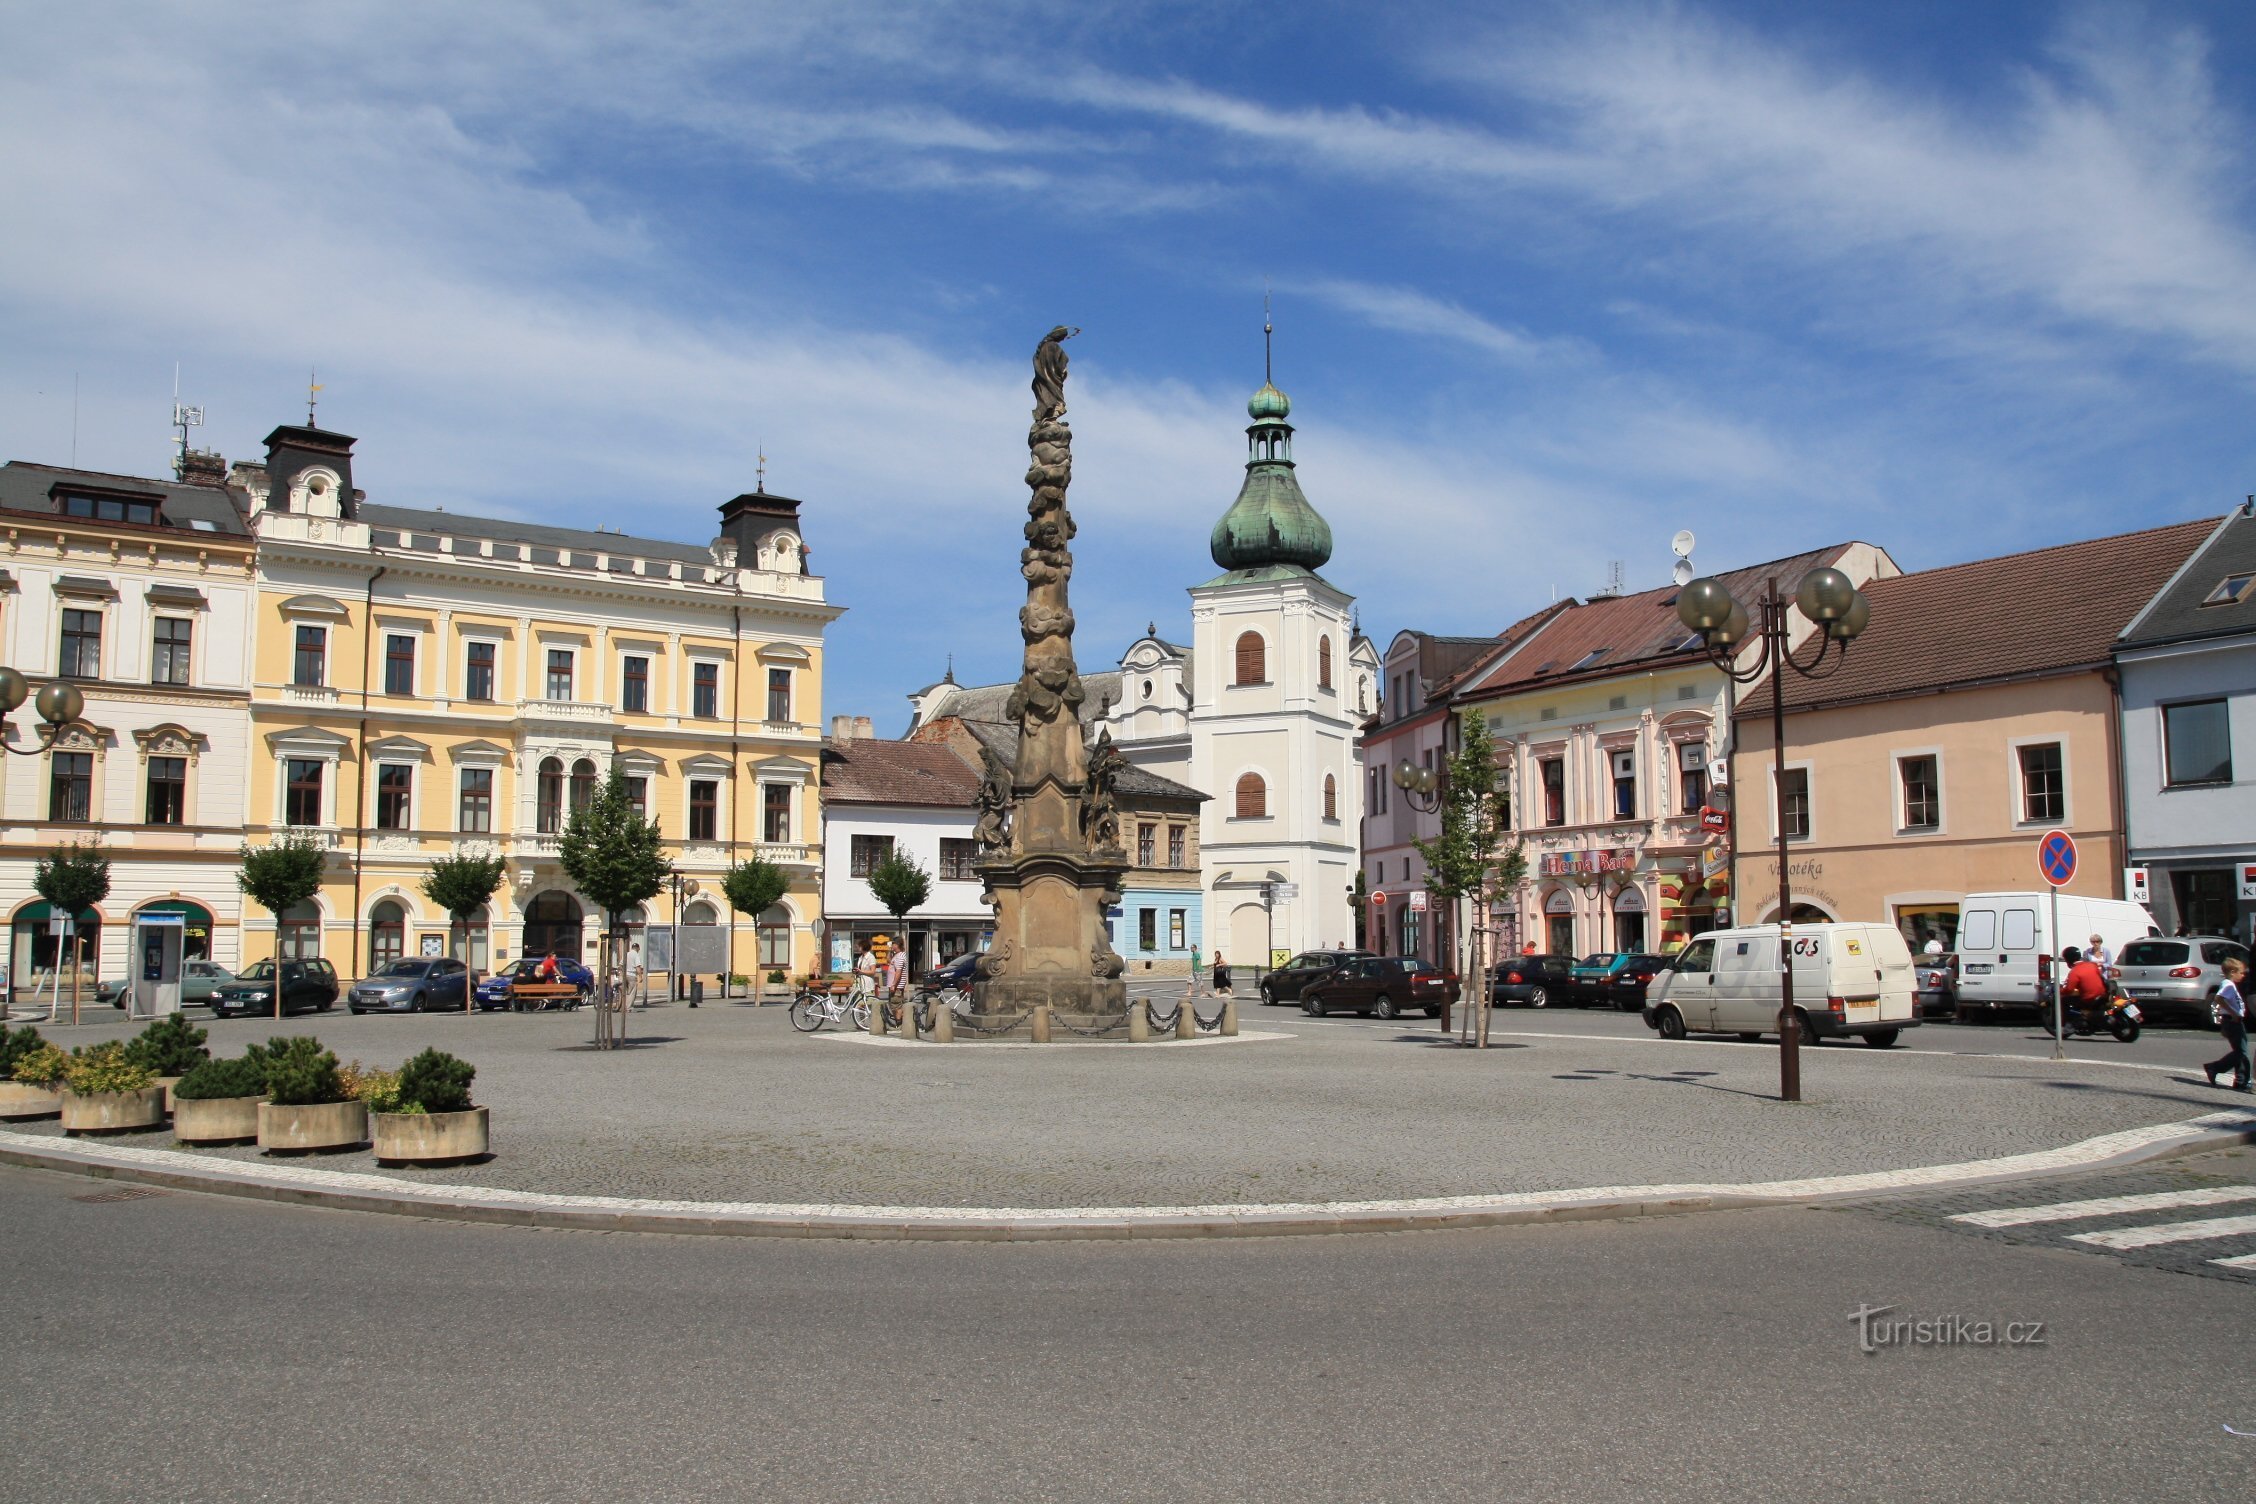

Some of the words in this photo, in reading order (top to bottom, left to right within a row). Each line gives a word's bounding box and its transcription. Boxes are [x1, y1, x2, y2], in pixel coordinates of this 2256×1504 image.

[1546, 856, 1593, 874] Herna
[1597, 852, 1627, 871] Bar
[1768, 858, 1823, 880] Viotéka
[2133, 891, 2147, 900] KB
[2243, 886, 2256, 896] K
[1794, 938, 1819, 957] G4S
